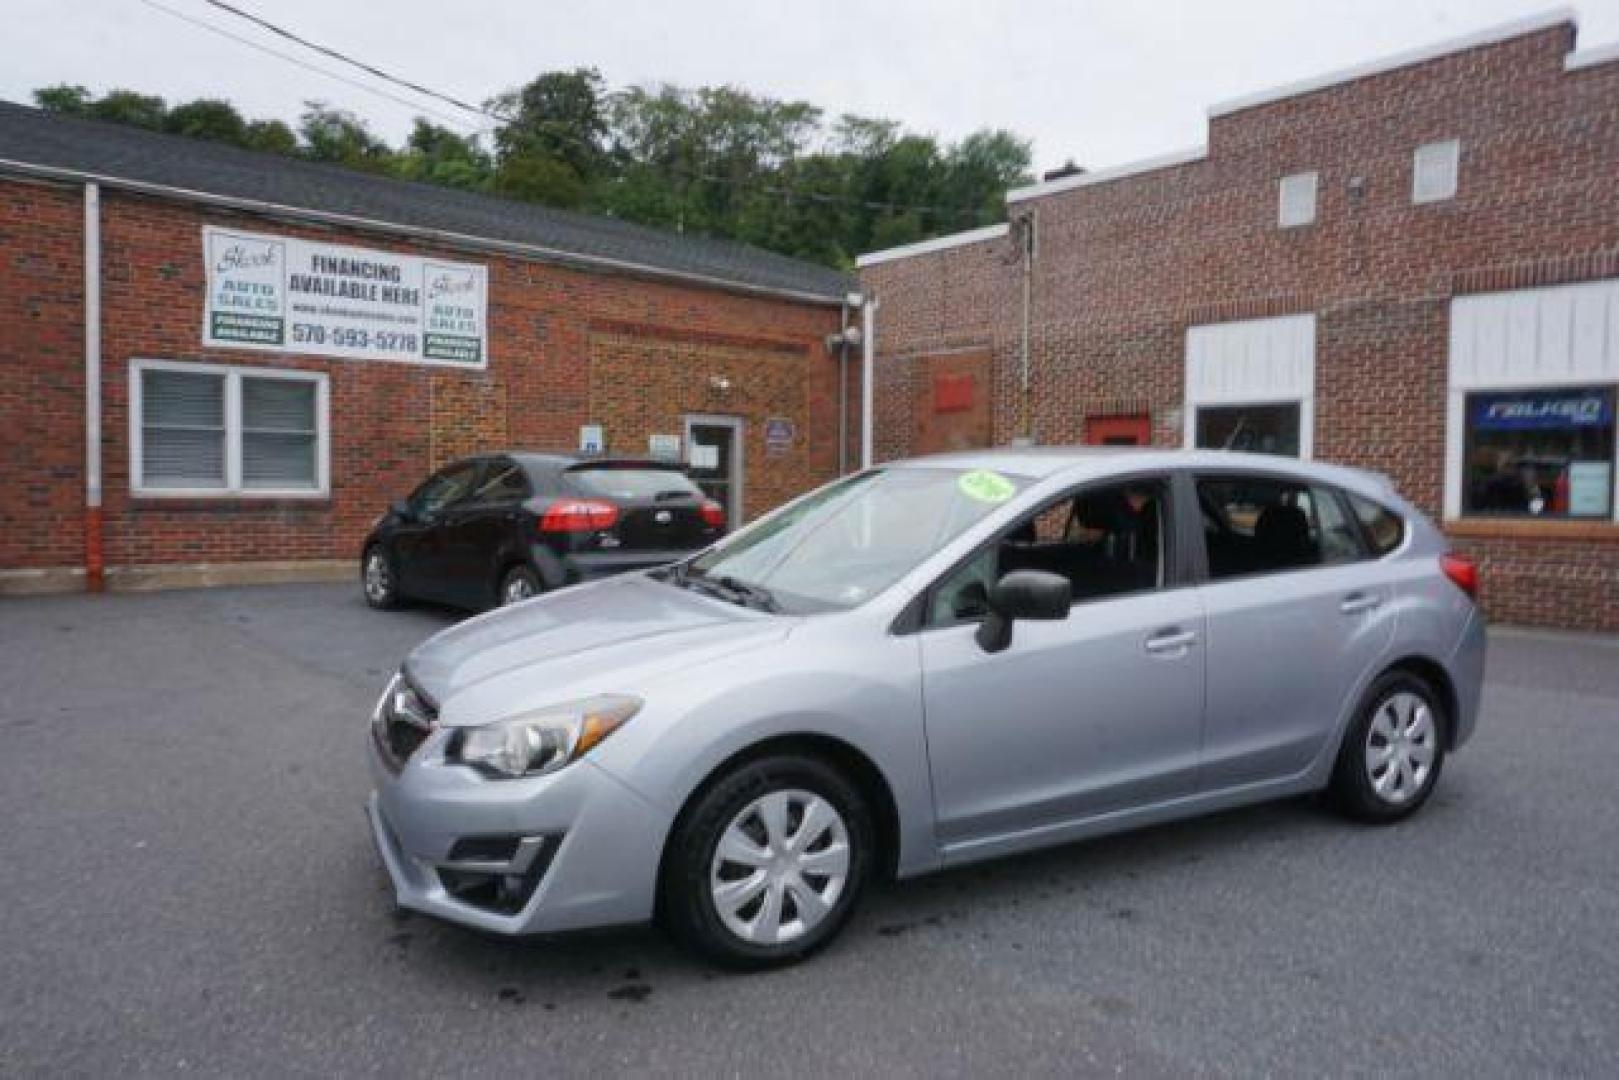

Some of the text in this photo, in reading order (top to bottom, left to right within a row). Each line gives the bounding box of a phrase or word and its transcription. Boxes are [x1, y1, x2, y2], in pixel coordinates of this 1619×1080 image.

[312, 255, 400, 283] FINANCING
[223, 280, 275, 296] AUTO
[290, 274, 418, 306] AVAILABLE HERE
